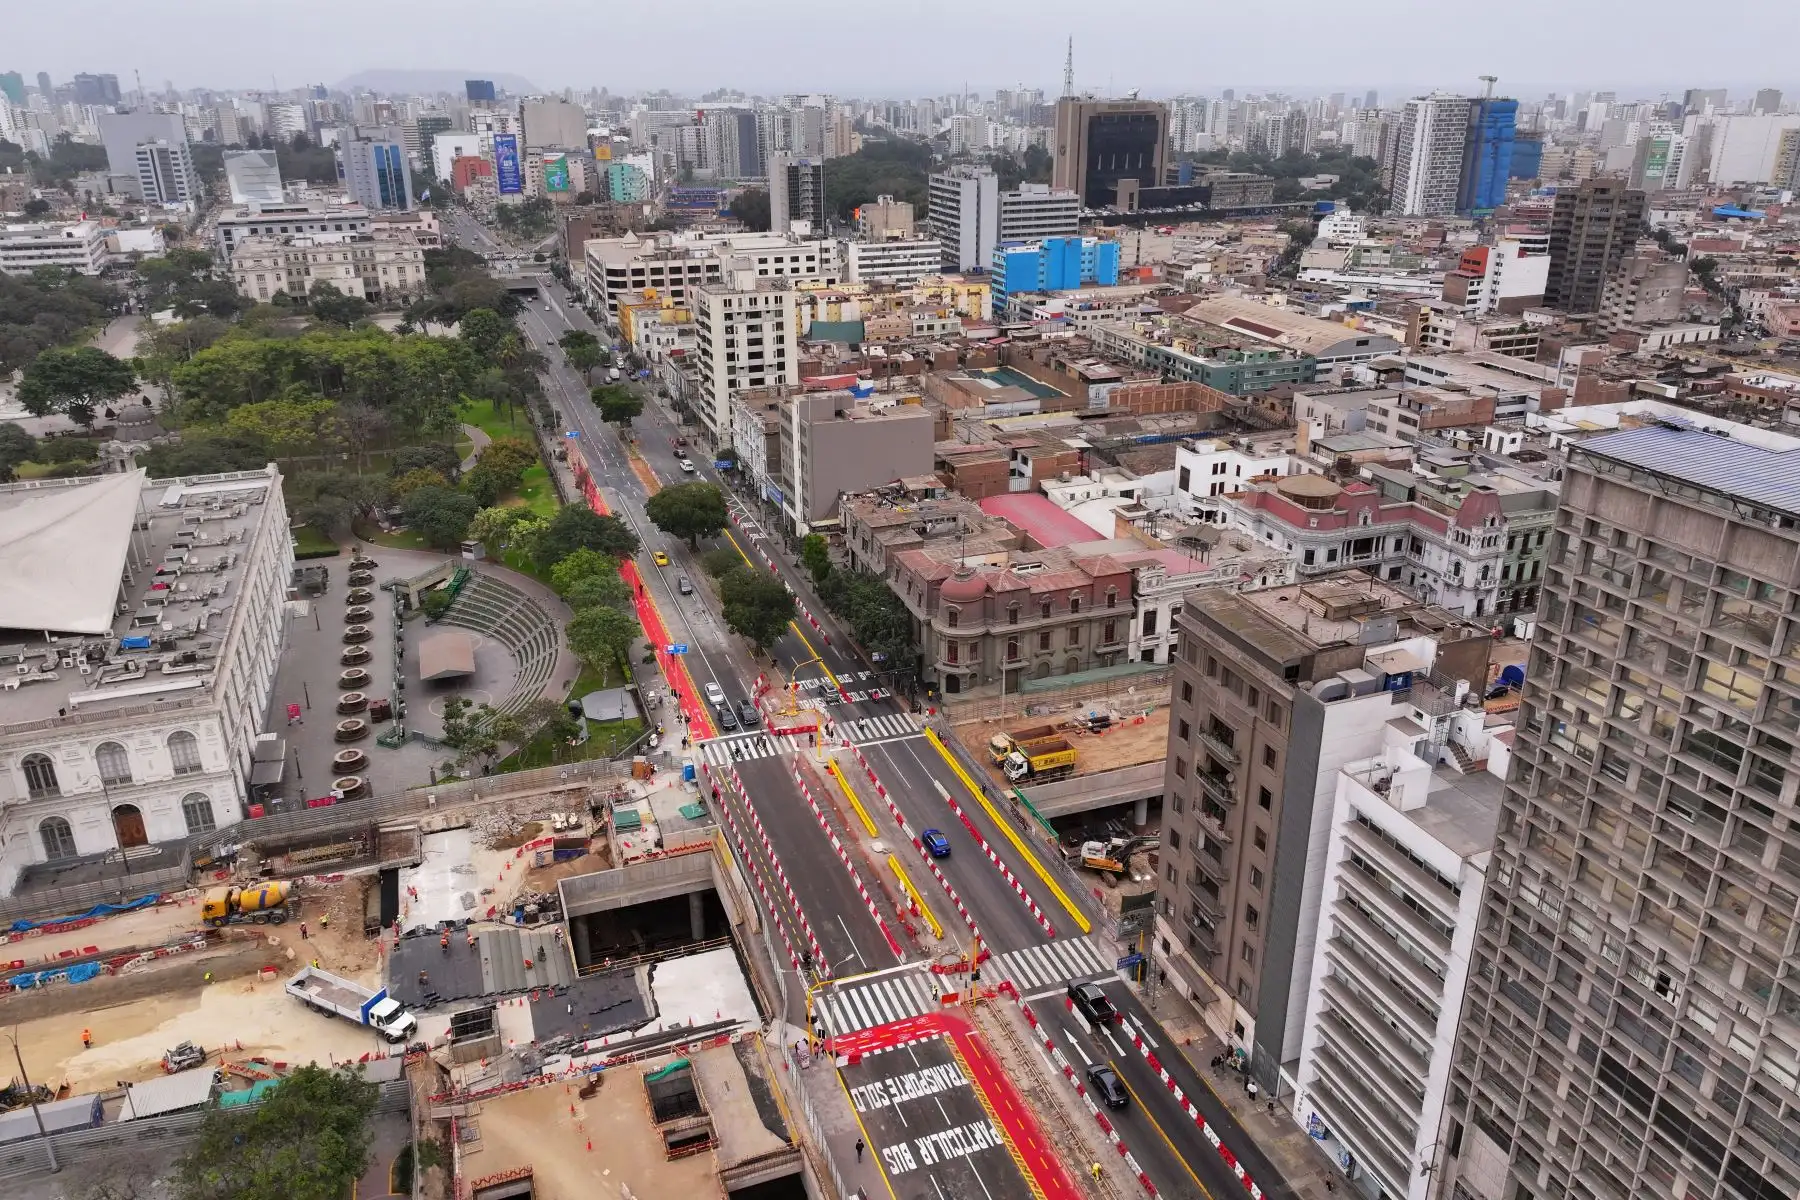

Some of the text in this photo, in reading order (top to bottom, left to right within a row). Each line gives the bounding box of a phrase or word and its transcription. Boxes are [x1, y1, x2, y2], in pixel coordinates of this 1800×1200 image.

[836, 673, 853, 683] BUS
[850, 1061, 969, 1113] TRANSPORTE SOLO
[882, 1118, 1004, 1175] PARTICULAR BUS
